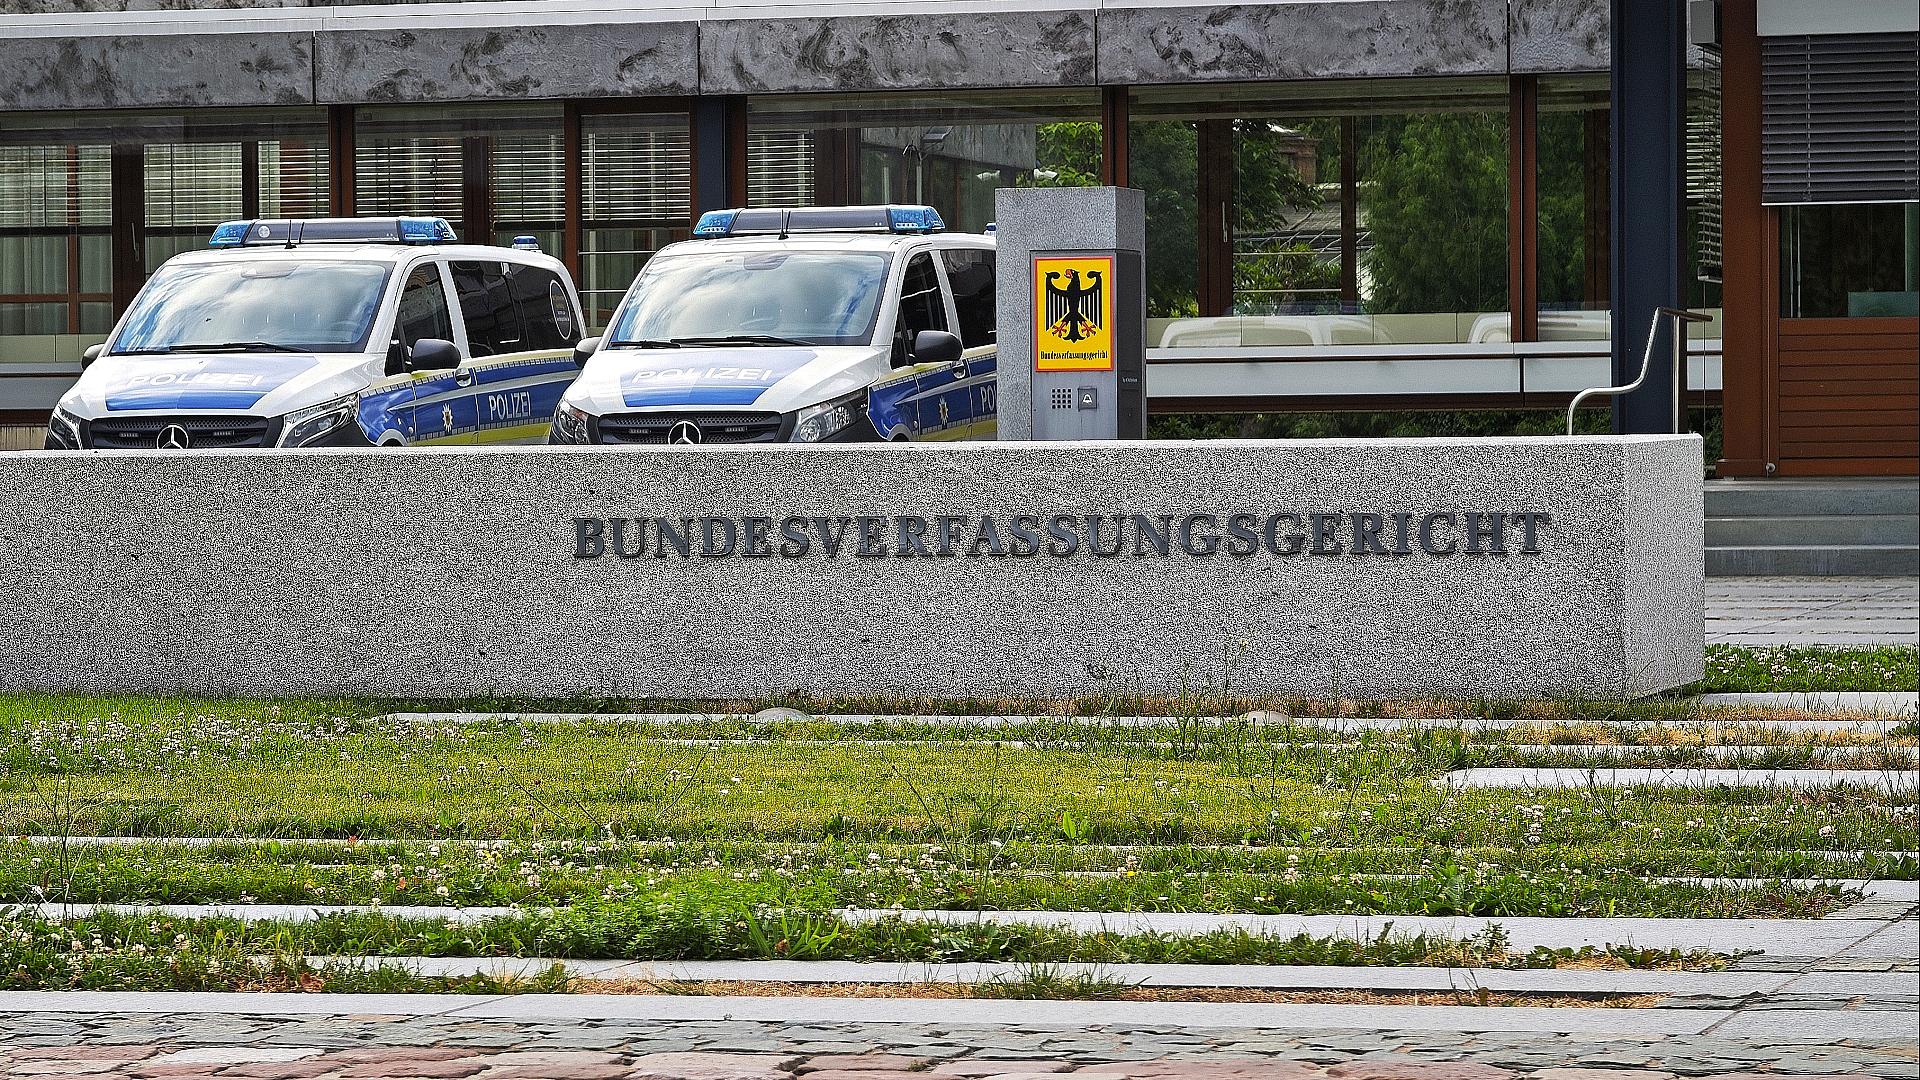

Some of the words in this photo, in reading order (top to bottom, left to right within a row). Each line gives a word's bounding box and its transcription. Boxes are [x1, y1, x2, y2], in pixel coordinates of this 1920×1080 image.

[1040, 350, 1108, 361] Bundesverfassungsgericht
[126, 372, 264, 388] POLIZEI
[631, 367, 773, 384] POLIZEI
[488, 391, 531, 421] POLIZEI
[573, 512, 1550, 558] BUNDESVERFASSUNGSGERICHT
